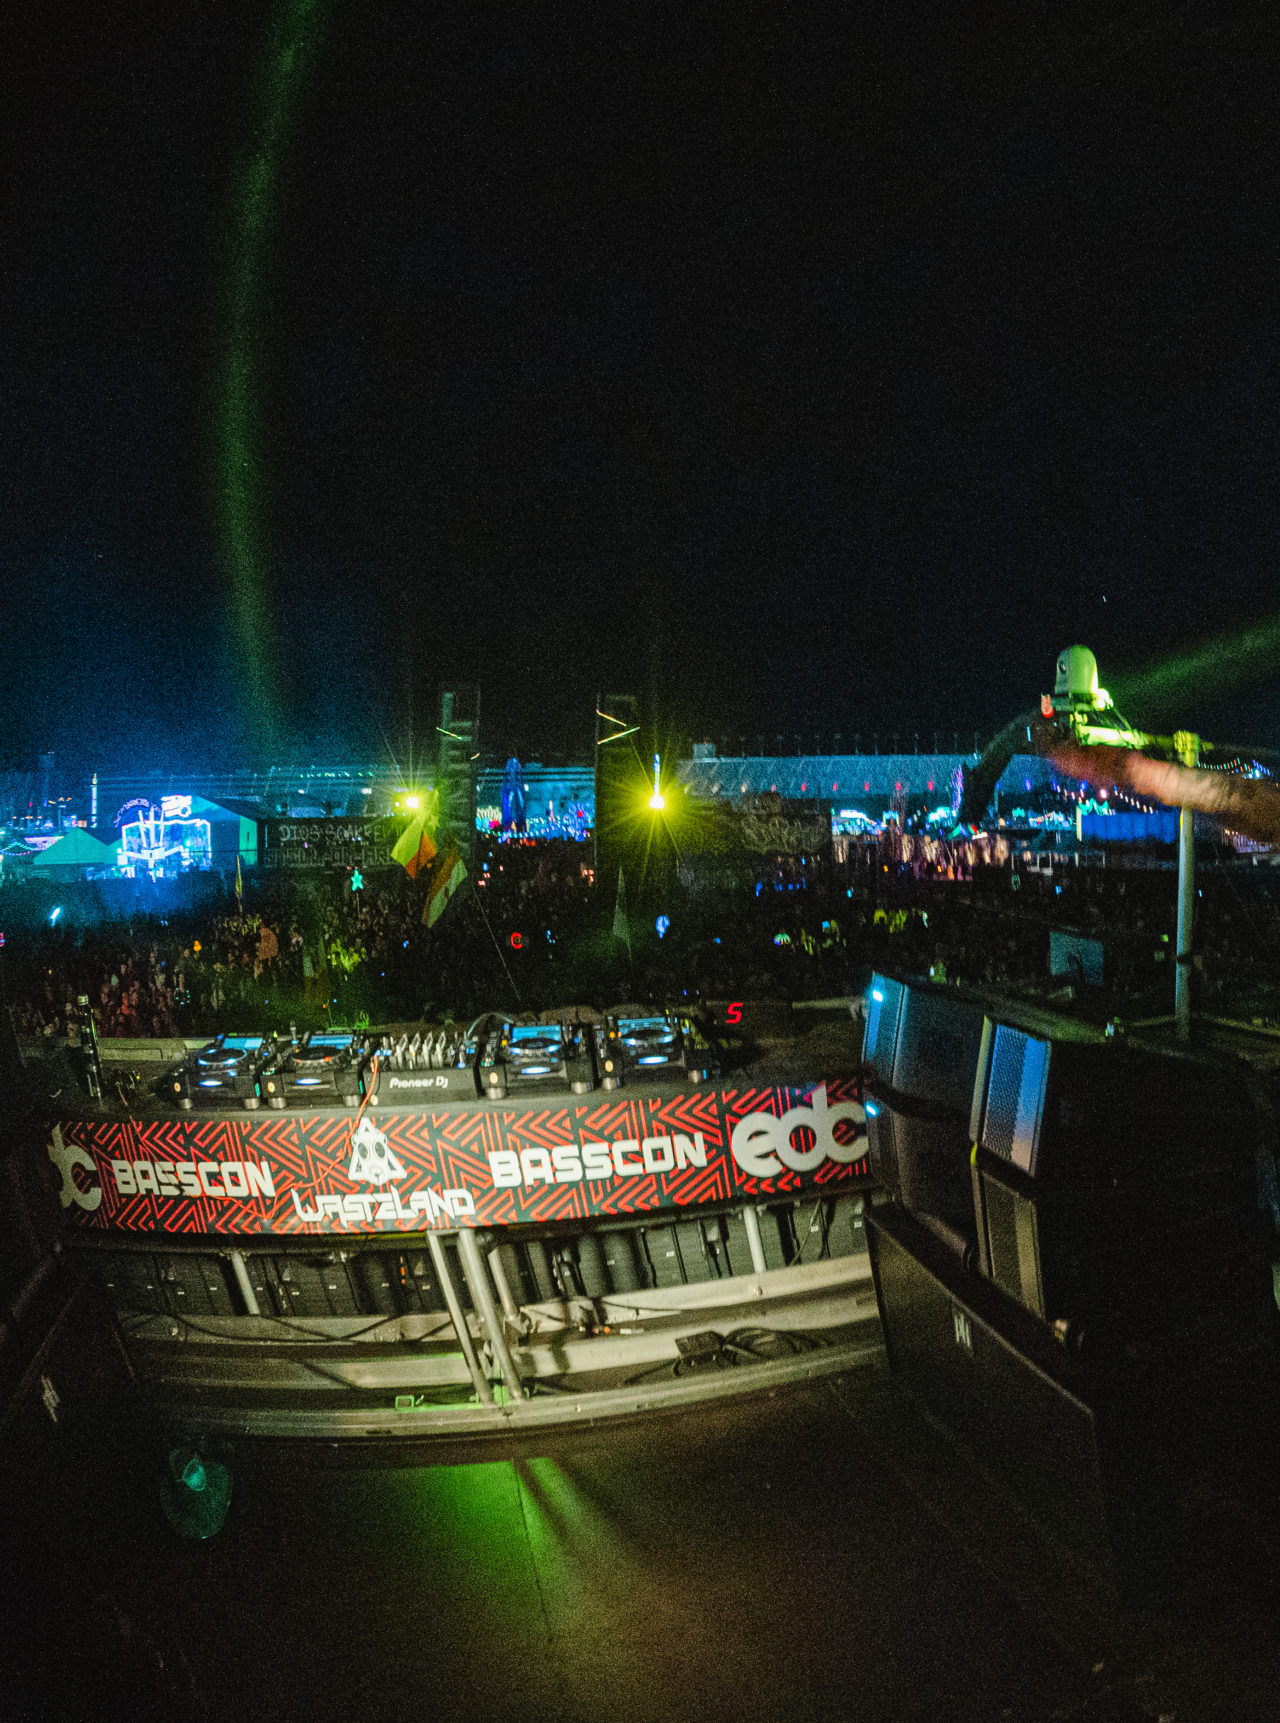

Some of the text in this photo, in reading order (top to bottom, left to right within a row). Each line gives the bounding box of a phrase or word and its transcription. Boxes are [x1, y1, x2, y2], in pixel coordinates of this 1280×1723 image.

[390, 1077, 434, 1089] Pioneer
[731, 1084, 869, 1178] edc
[111, 1160, 276, 1197] BASSCON
[488, 1132, 708, 1188] BASSCON
[291, 1185, 476, 1229] WASTELAND
